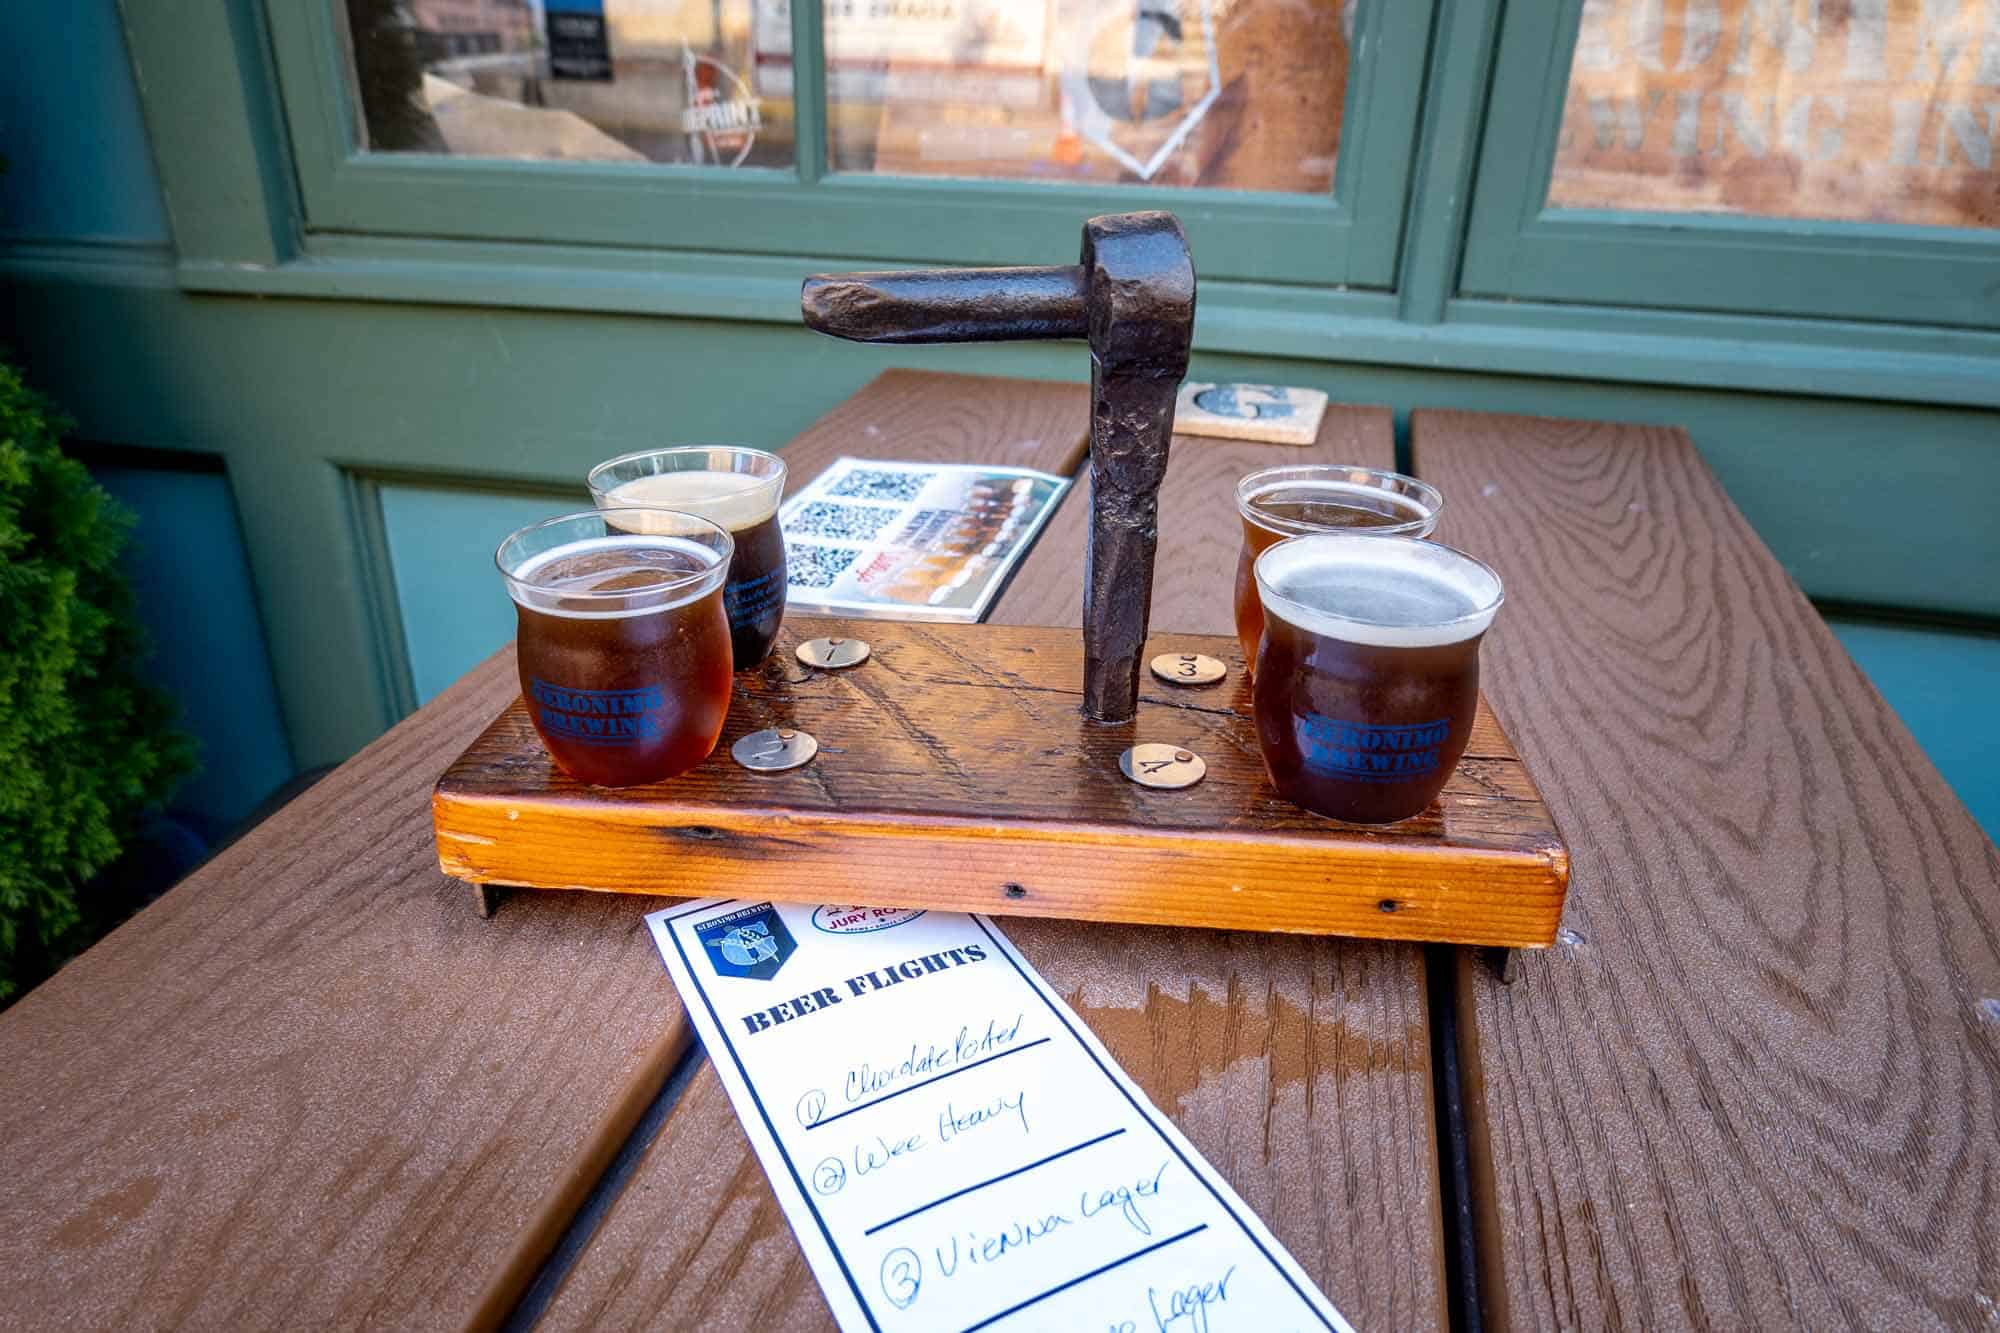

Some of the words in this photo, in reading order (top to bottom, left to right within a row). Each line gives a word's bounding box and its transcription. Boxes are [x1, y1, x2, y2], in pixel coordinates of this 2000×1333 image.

[1177, 662, 1198, 677] 3
[829, 911, 867, 930] JURY
[741, 986, 843, 1036] BEER
[843, 943, 988, 998] FLIGHTS
[855, 1136, 923, 1176] Wee
[939, 1090, 1030, 1142] Heavy
[1081, 1159, 1170, 1236] Lager
